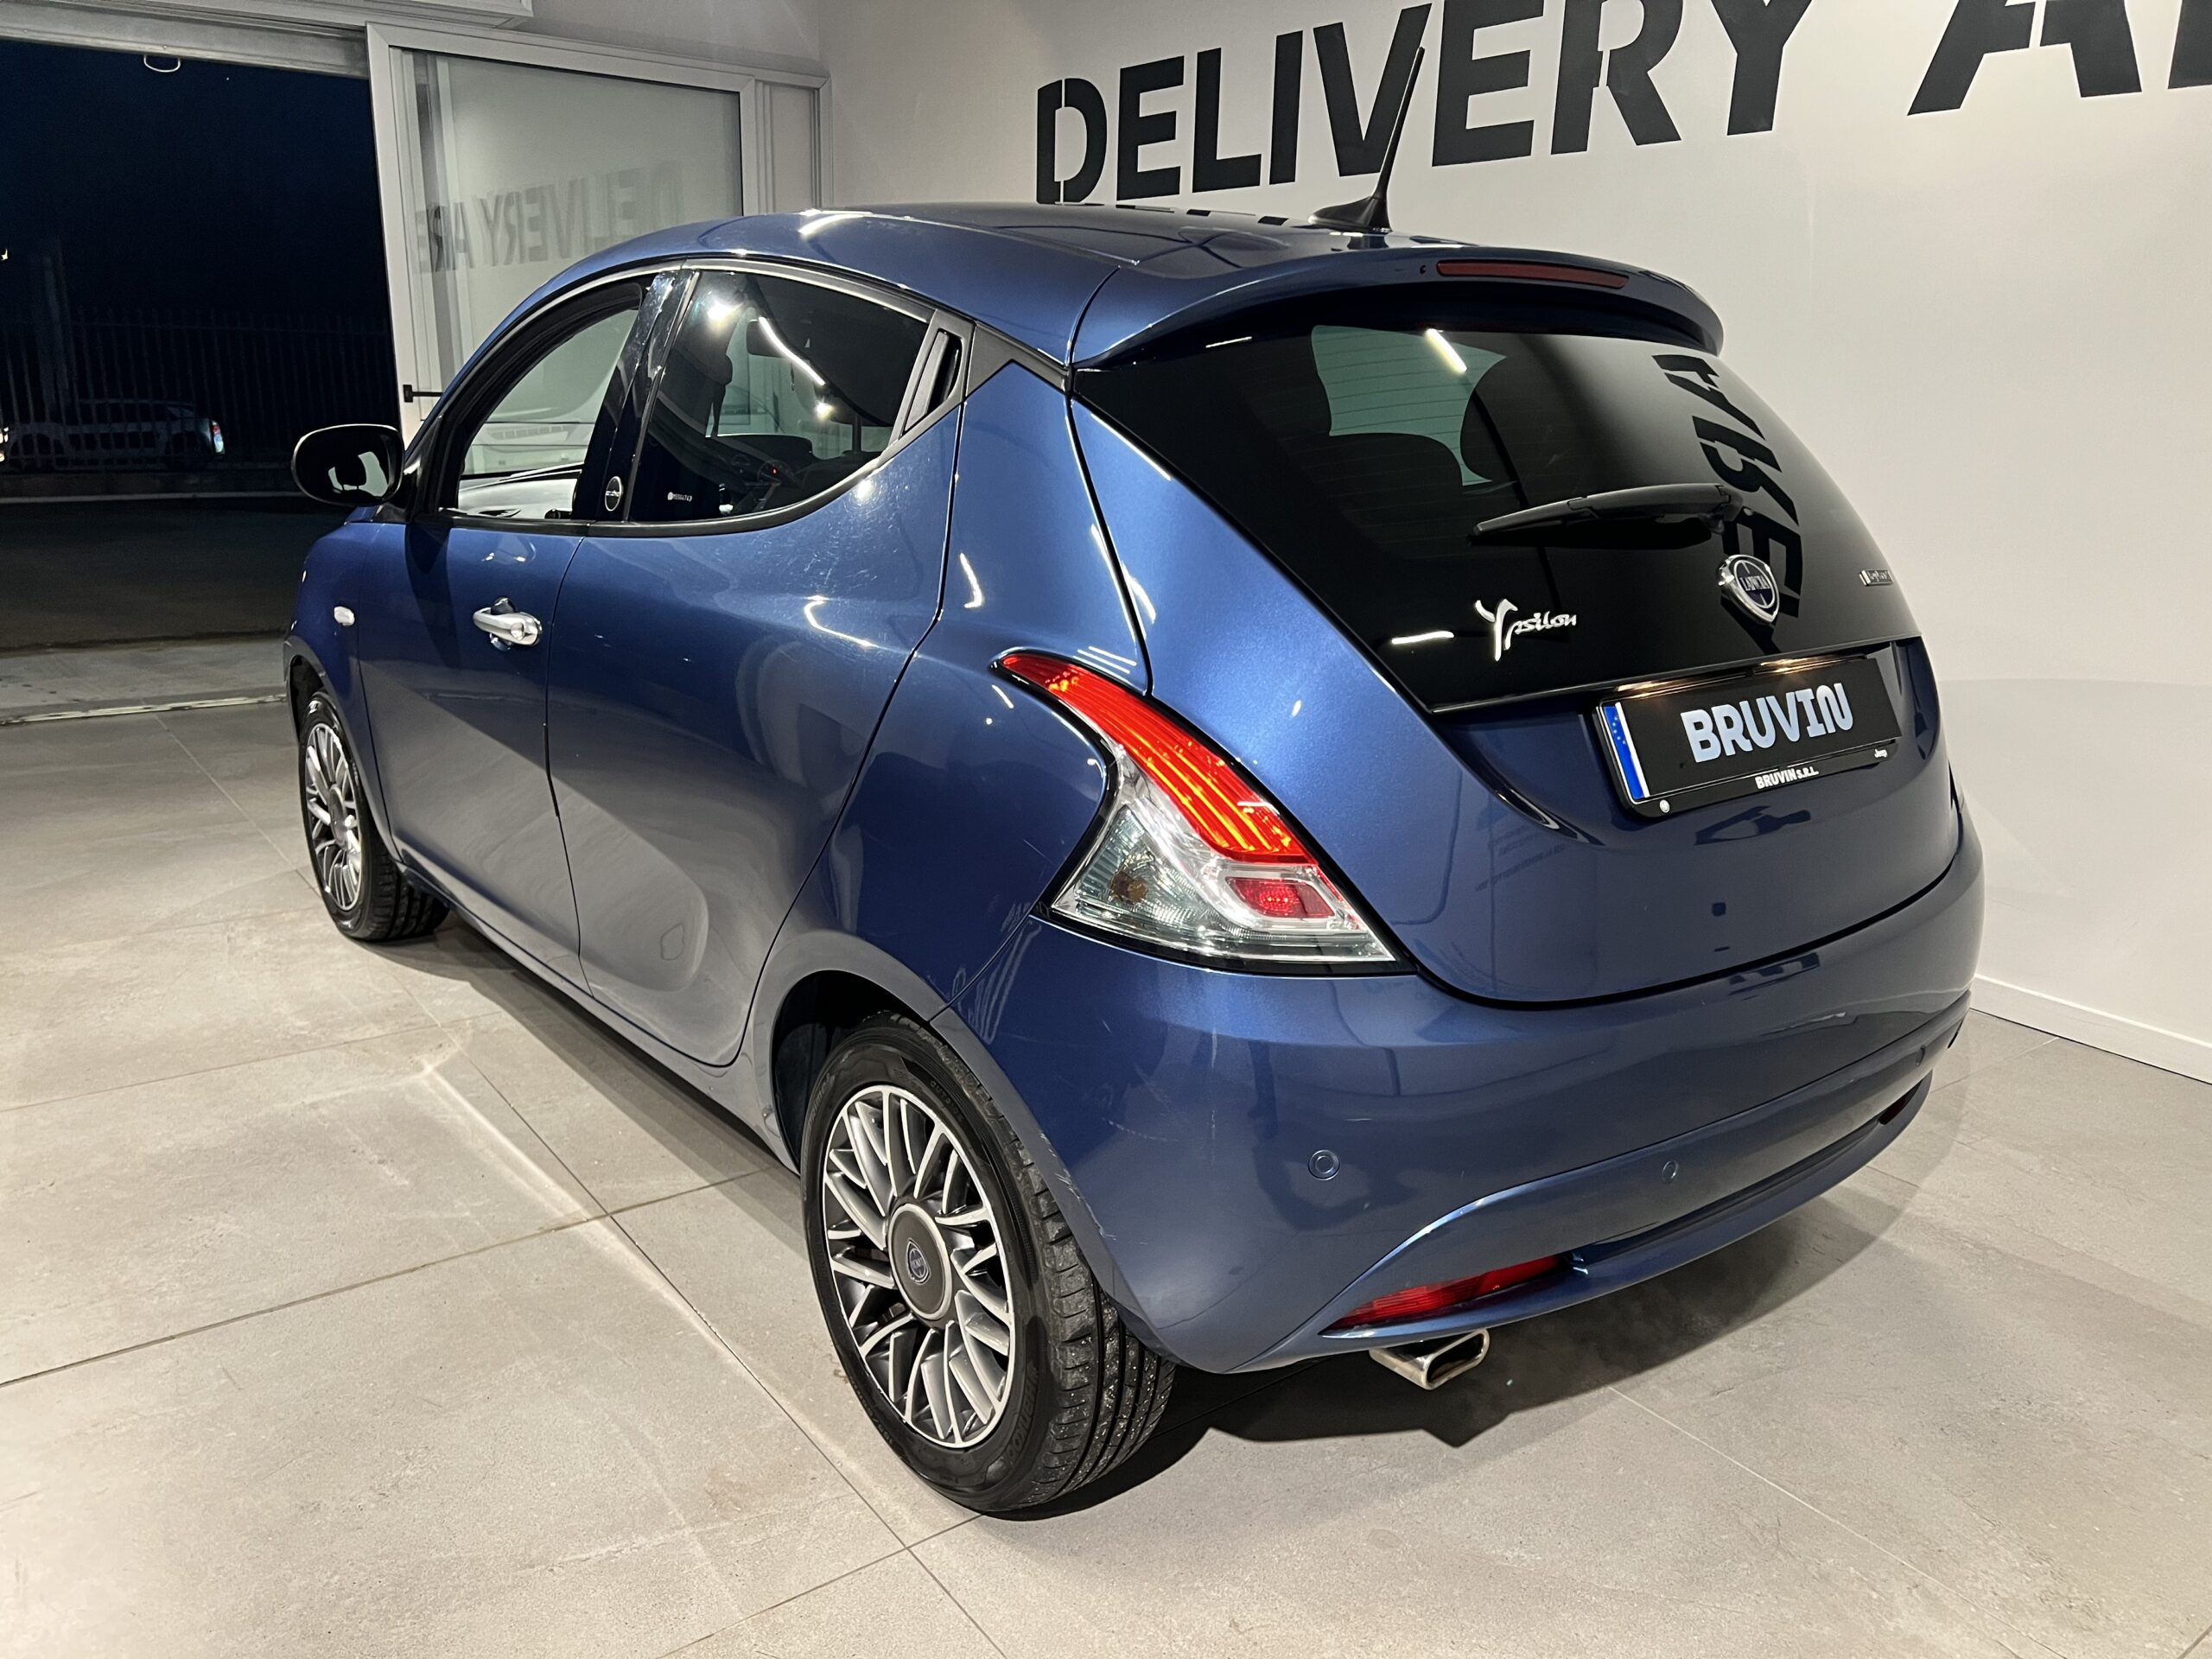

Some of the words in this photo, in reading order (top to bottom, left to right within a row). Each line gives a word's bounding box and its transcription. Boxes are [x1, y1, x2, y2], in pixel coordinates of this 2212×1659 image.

[1036, 0, 1815, 204] DELIVERY
[1474, 598, 1577, 662] Ypsilon
[1680, 683, 1854, 763] BRUVIN
[1755, 767, 1797, 790] BRUVIN
